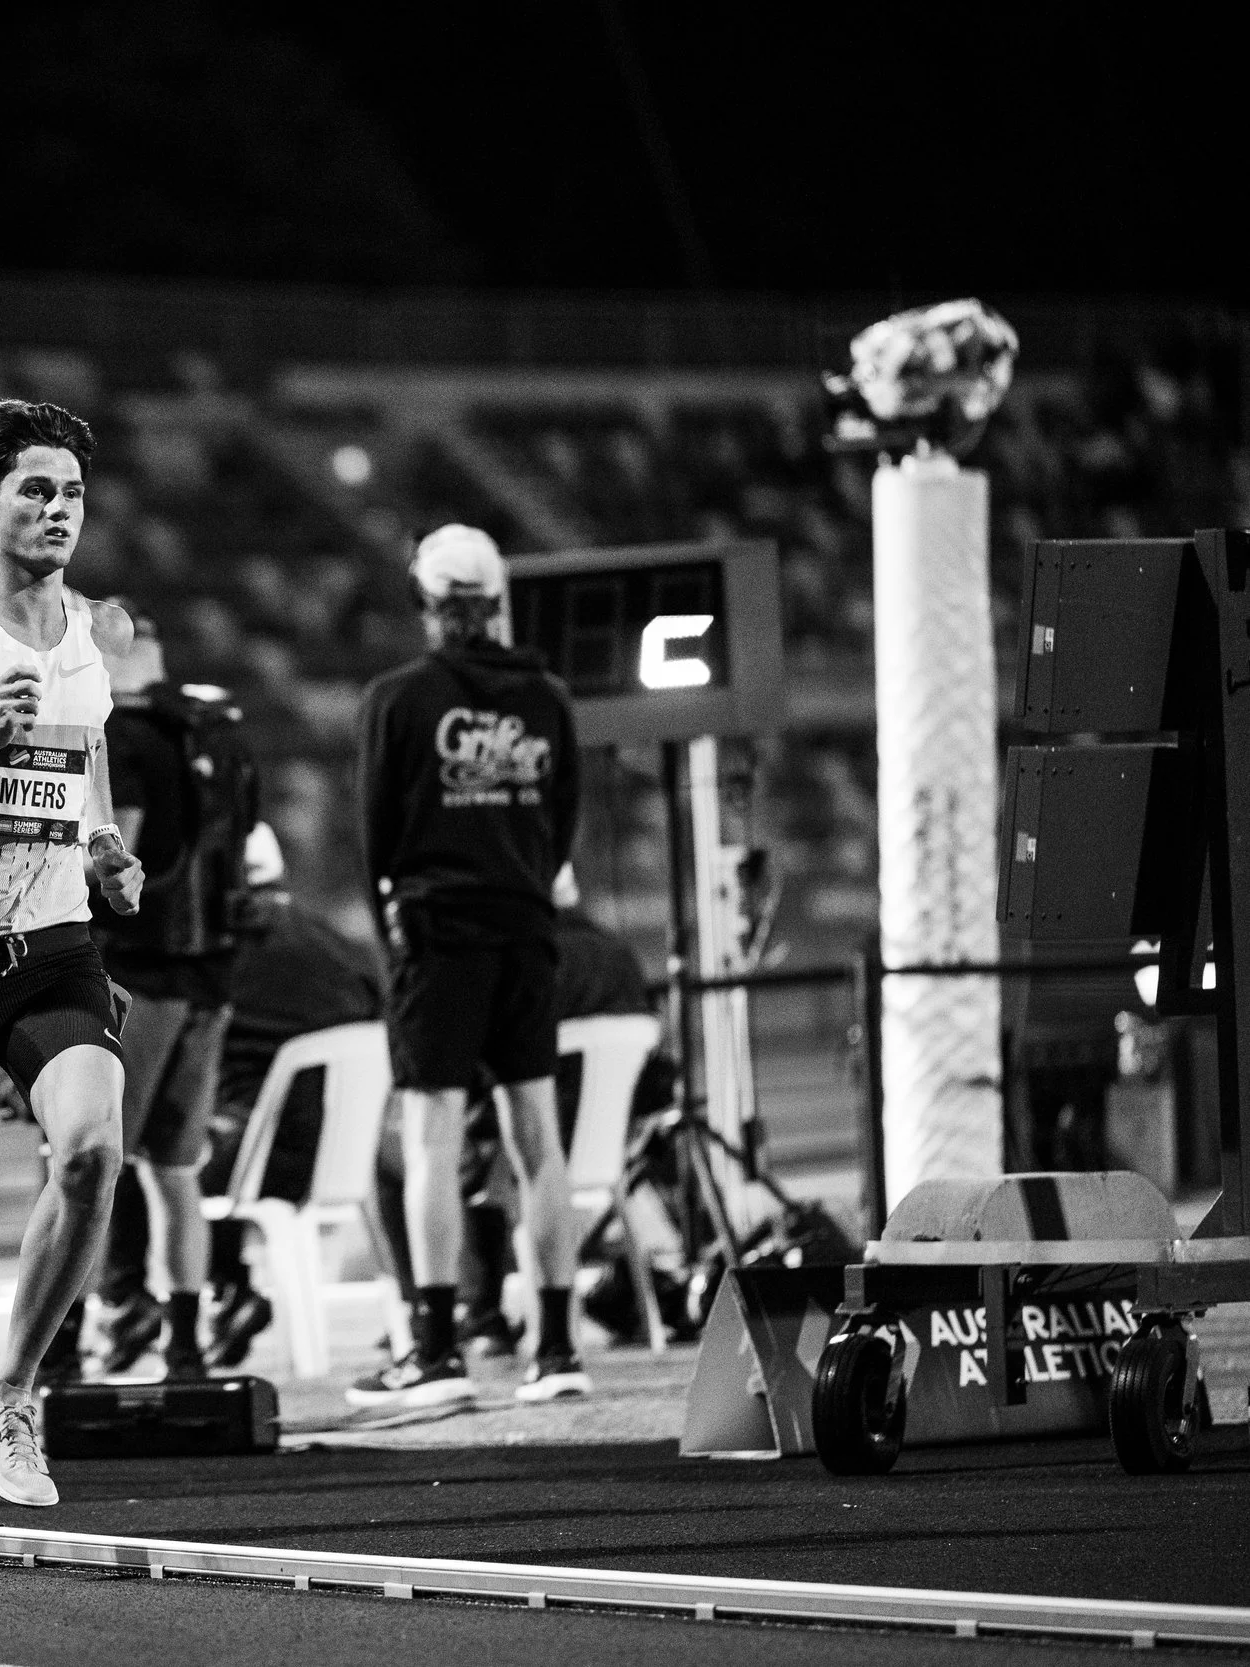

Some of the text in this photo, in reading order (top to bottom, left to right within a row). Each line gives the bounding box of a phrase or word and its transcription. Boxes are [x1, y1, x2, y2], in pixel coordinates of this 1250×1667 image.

[34, 750, 67, 758] AUSTRALIAN
[33, 755, 66, 764] ATHLETICS
[0, 778, 66, 809] MYERS
[14, 821, 42, 829] SUMMER
[13, 827, 34, 835] SERIES
